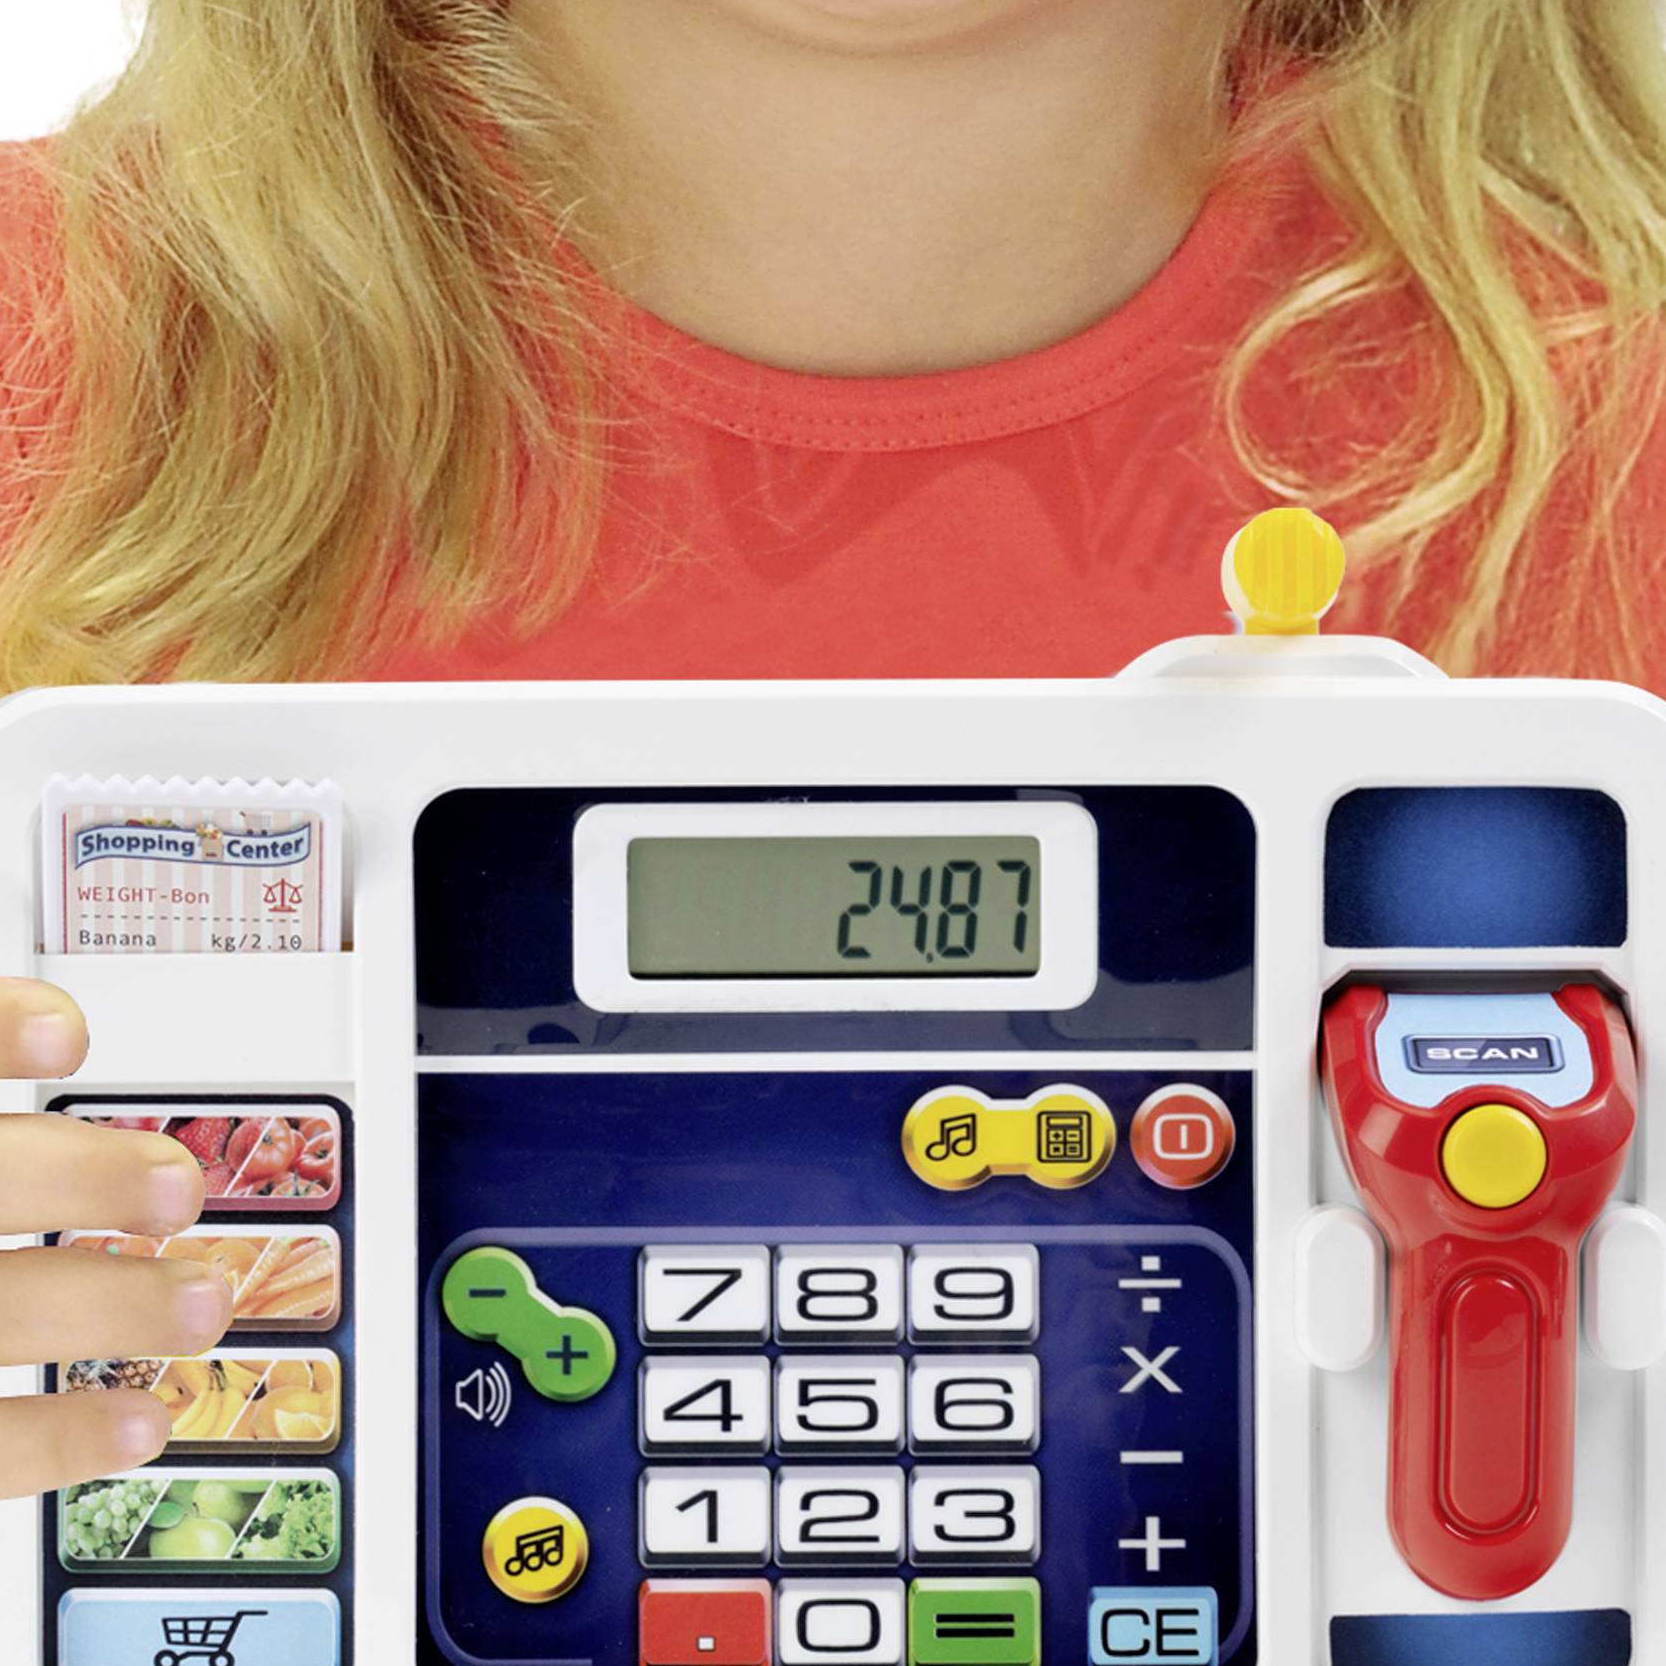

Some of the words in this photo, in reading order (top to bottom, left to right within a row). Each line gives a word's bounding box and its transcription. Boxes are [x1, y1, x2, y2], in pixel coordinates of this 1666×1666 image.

[81, 834, 196, 858] Shopping
[226, 836, 304, 860] Center
[77, 886, 210, 905] WEIGHT-Bon
[78, 930, 157, 947] Banana
[211, 933, 302, 952] kg/2.10
[1427, 1047, 1539, 1060] SCAN
[663, 1267, 743, 1321] 7
[797, 1267, 879, 1321] 8
[934, 1267, 1015, 1321] 9
[663, 1378, 743, 1433] 4
[797, 1378, 879, 1433] 5
[934, 1378, 1015, 1433] 6
[676, 1489, 720, 1544] 1
[799, 1489, 880, 1544] 2
[934, 1489, 1016, 1544] 3
[797, 1597, 880, 1653] 0
[1100, 1607, 1200, 1658] CE
